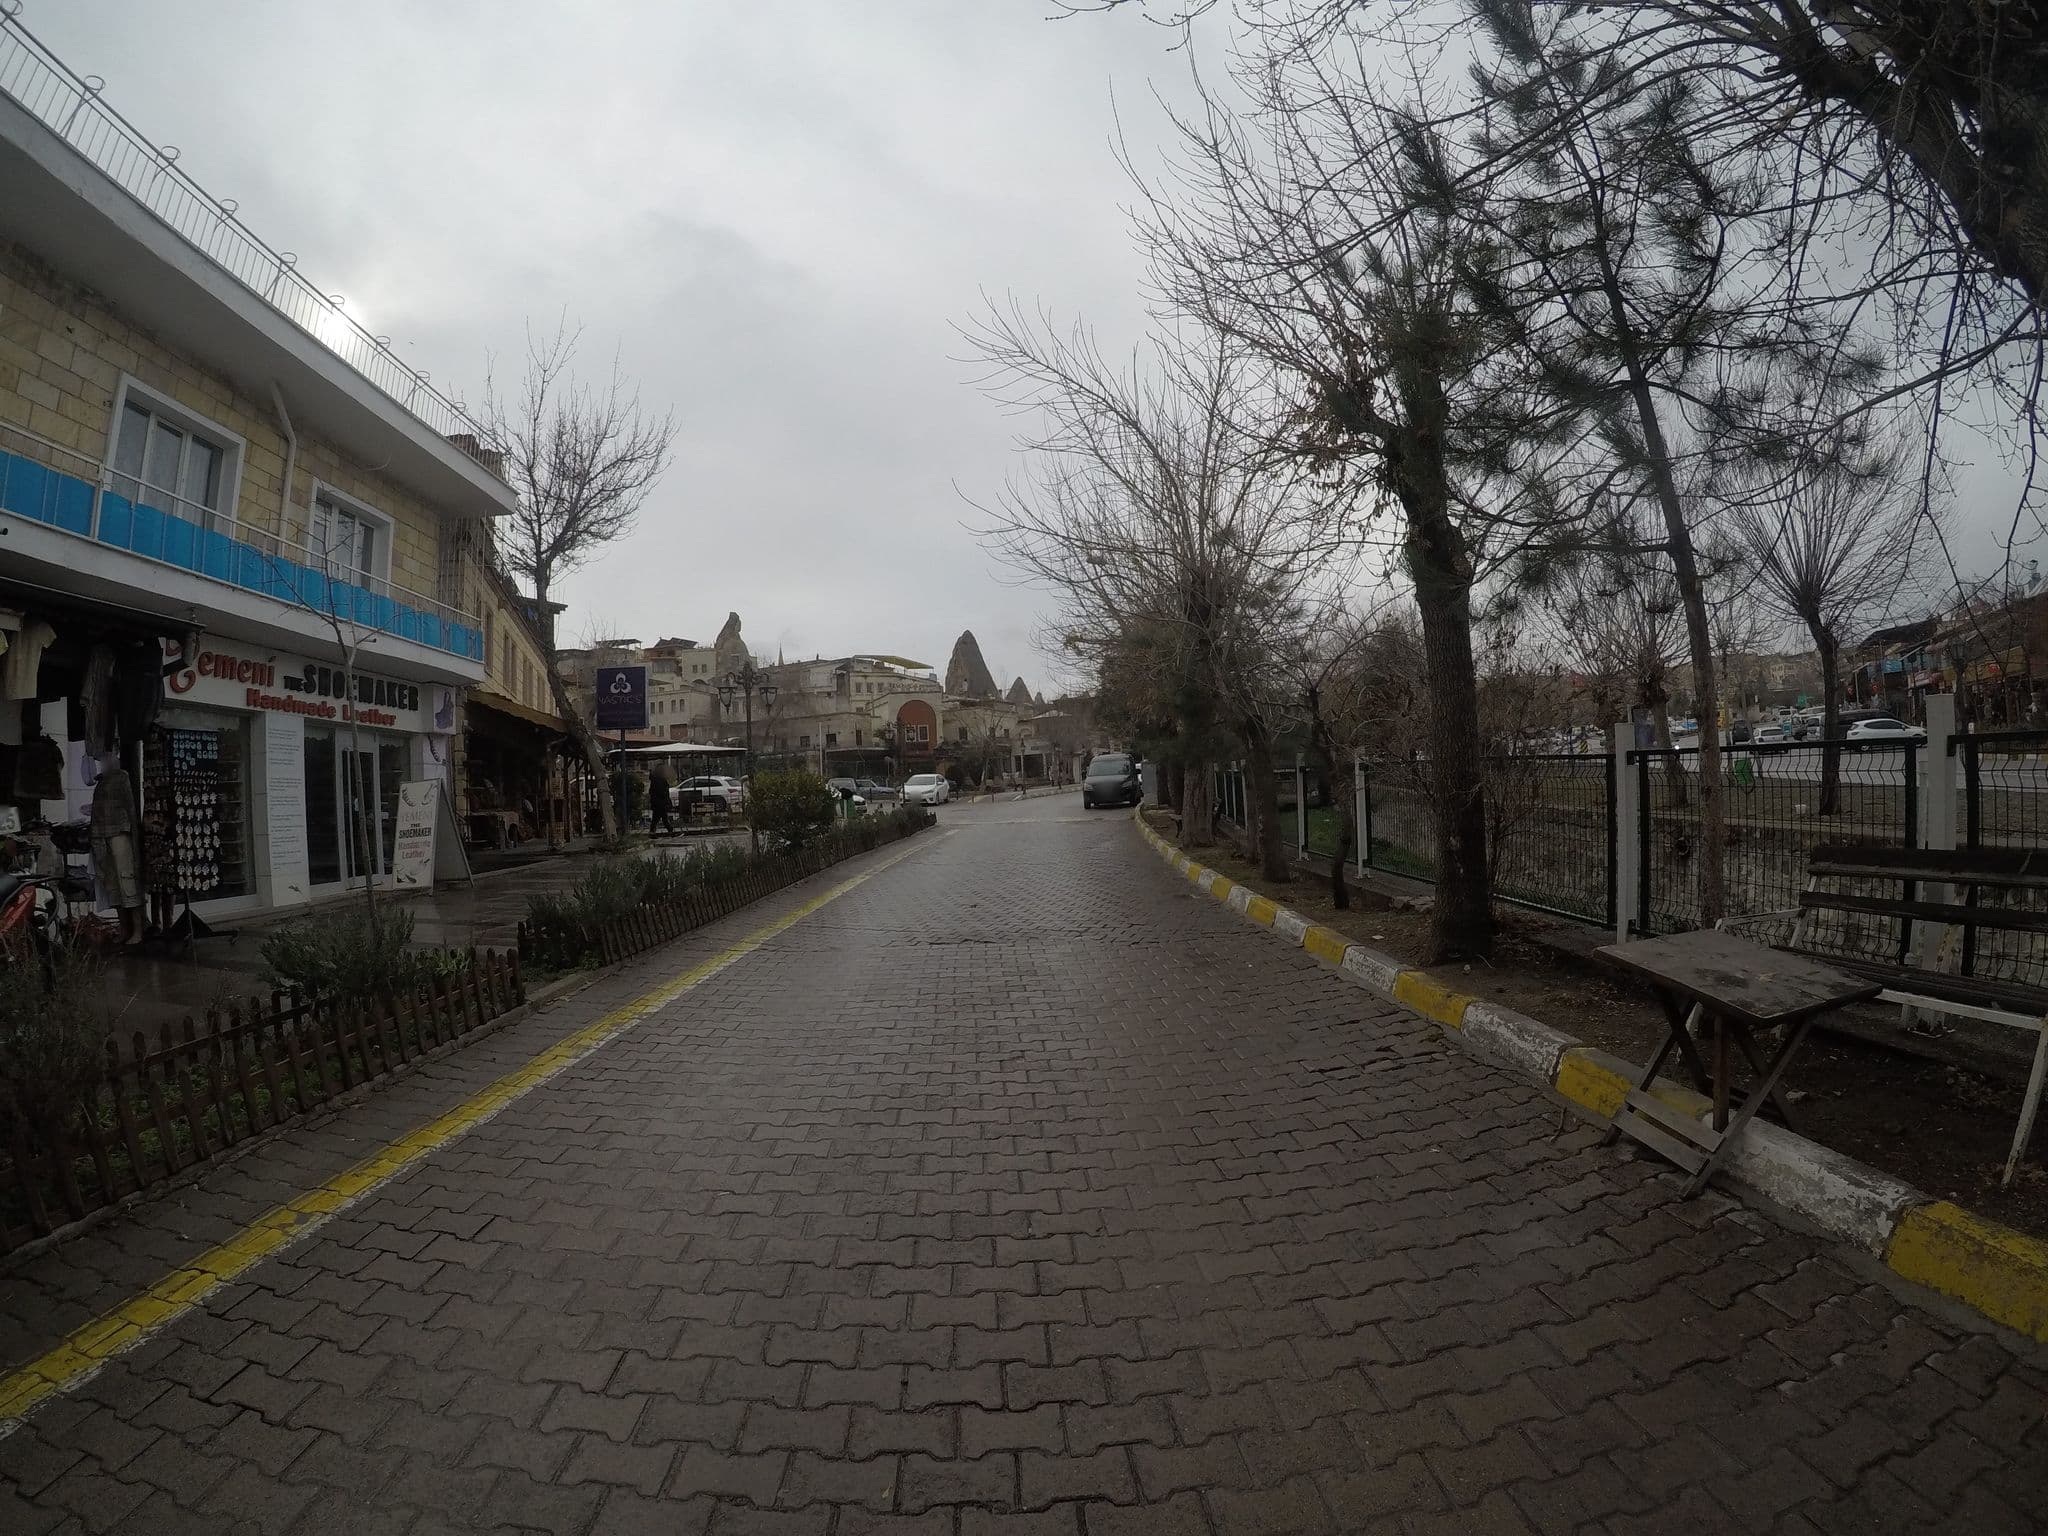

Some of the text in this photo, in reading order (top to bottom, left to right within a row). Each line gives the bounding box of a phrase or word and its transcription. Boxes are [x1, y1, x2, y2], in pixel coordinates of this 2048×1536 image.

[304, 664, 419, 711] SHOEMAKER
[247, 688, 337, 718] Handmade
[398, 827, 432, 839] SHOEMAKER
